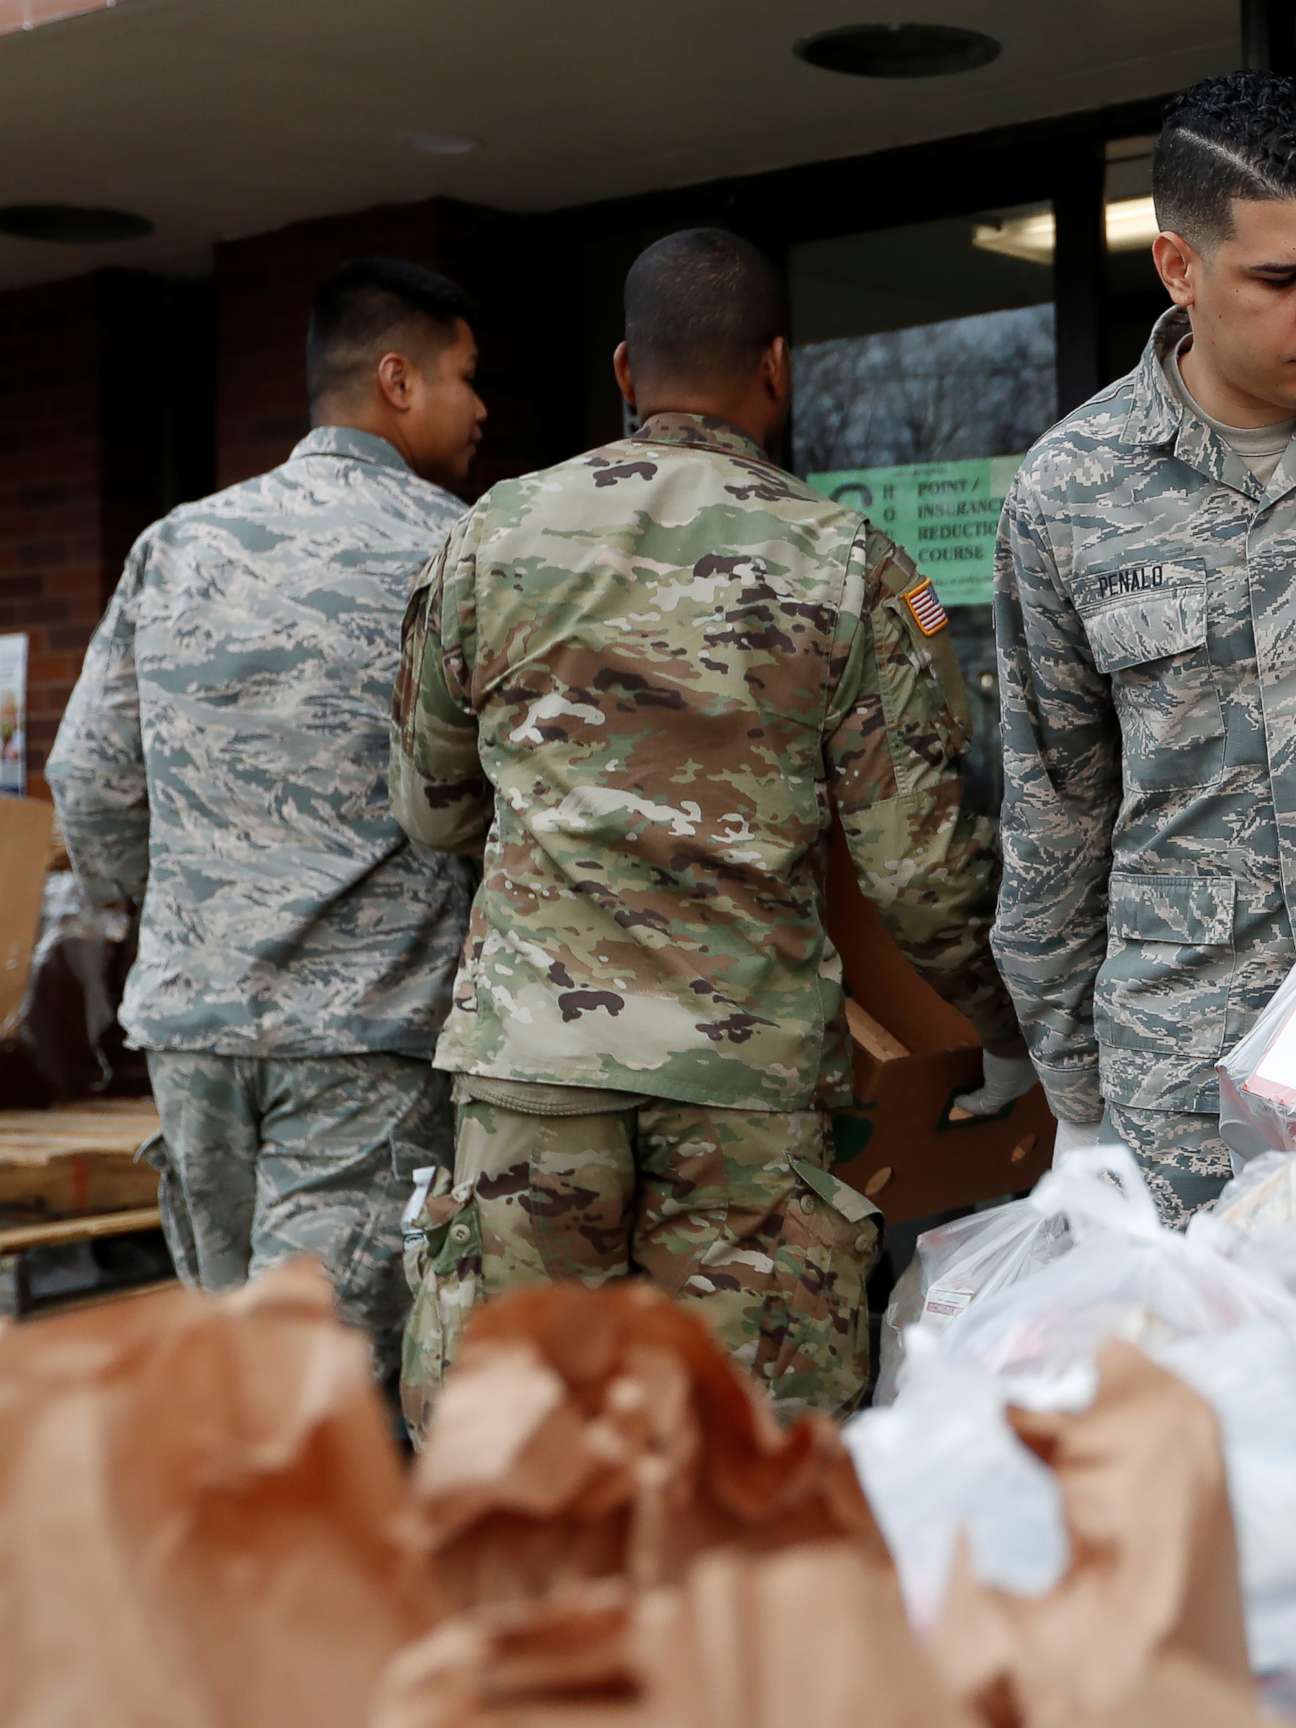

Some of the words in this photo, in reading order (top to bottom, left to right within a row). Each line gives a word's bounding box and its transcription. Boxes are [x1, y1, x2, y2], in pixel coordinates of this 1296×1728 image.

[917, 478, 966, 497] POINT
[917, 520, 999, 541] REDUCTIO
[918, 543, 984, 563] COURSE
[1098, 565, 1163, 599] PENALO
